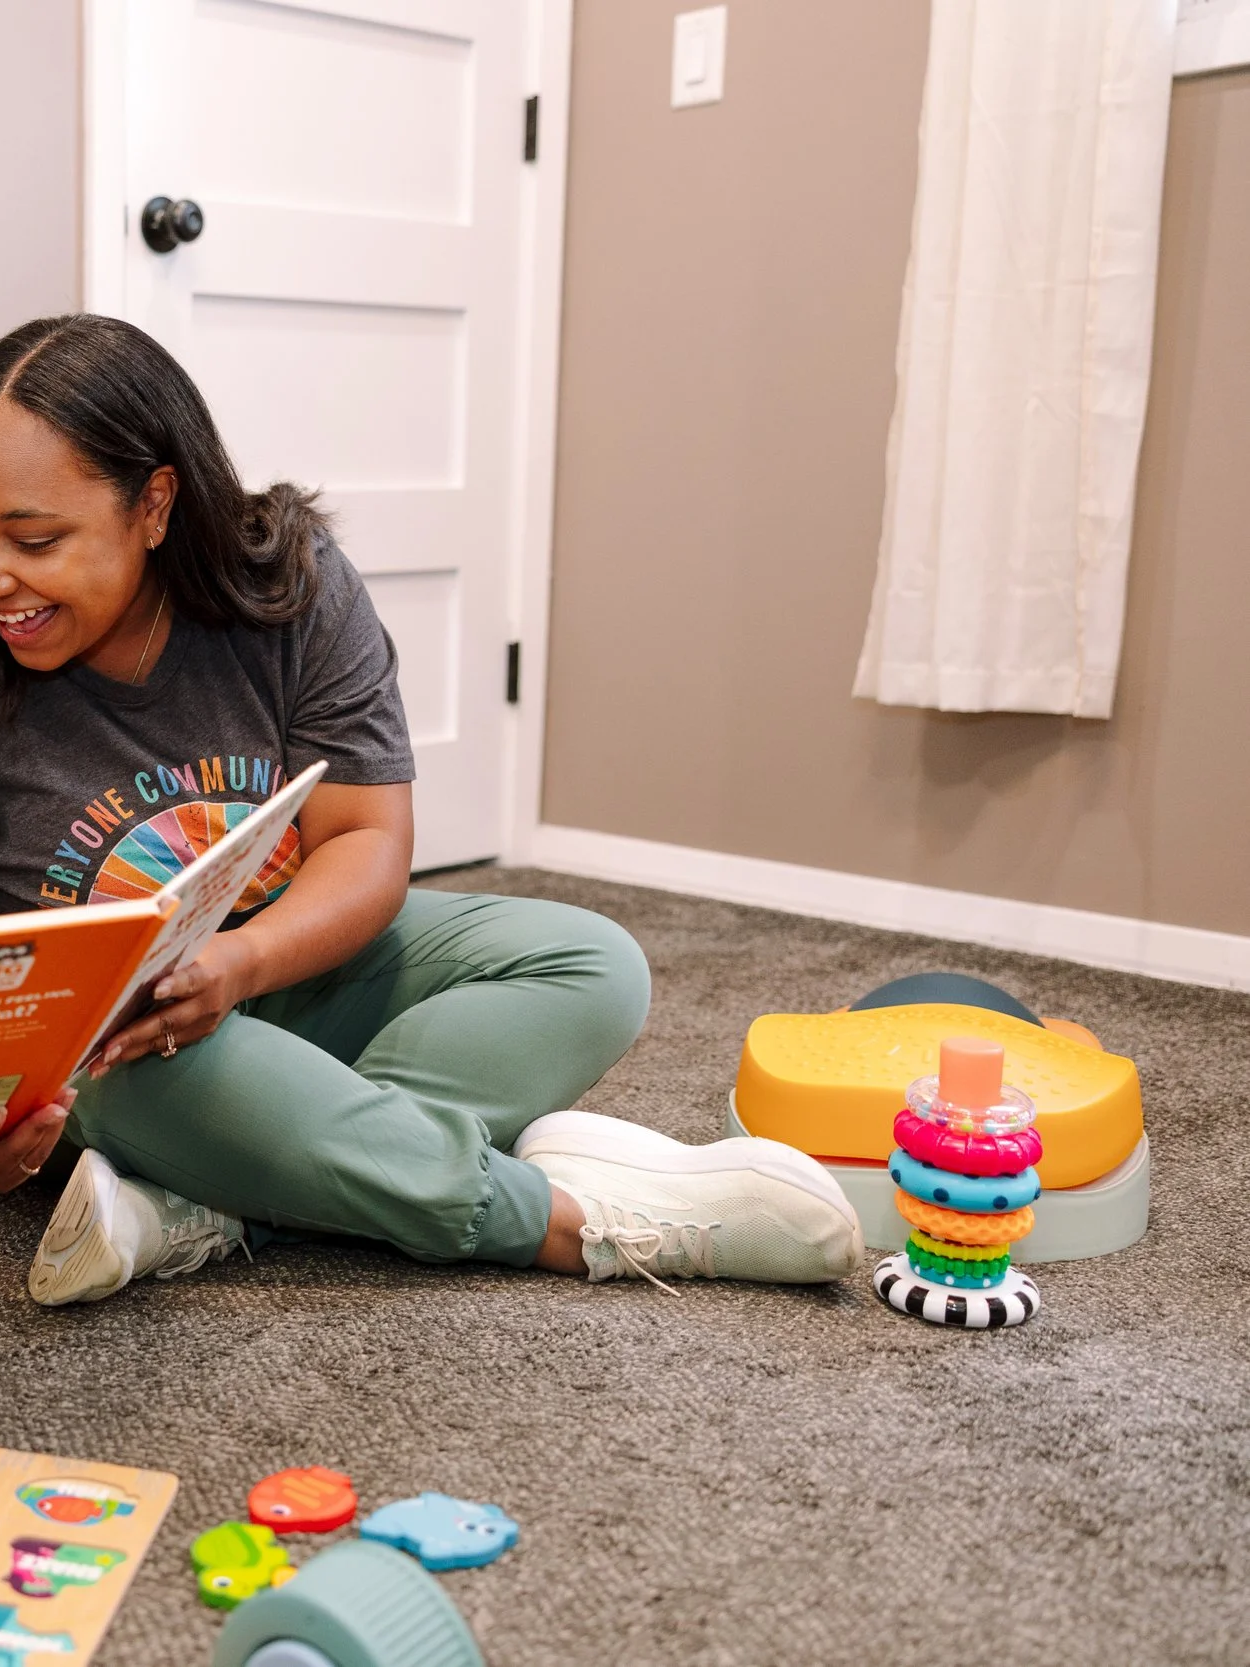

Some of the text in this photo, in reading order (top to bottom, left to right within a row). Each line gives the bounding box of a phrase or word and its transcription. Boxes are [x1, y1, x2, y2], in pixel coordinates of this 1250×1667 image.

[37, 788, 135, 908] ERYONE
[135, 755, 287, 804] COMMUNI
[16, 1553, 103, 1581] SNAKE
